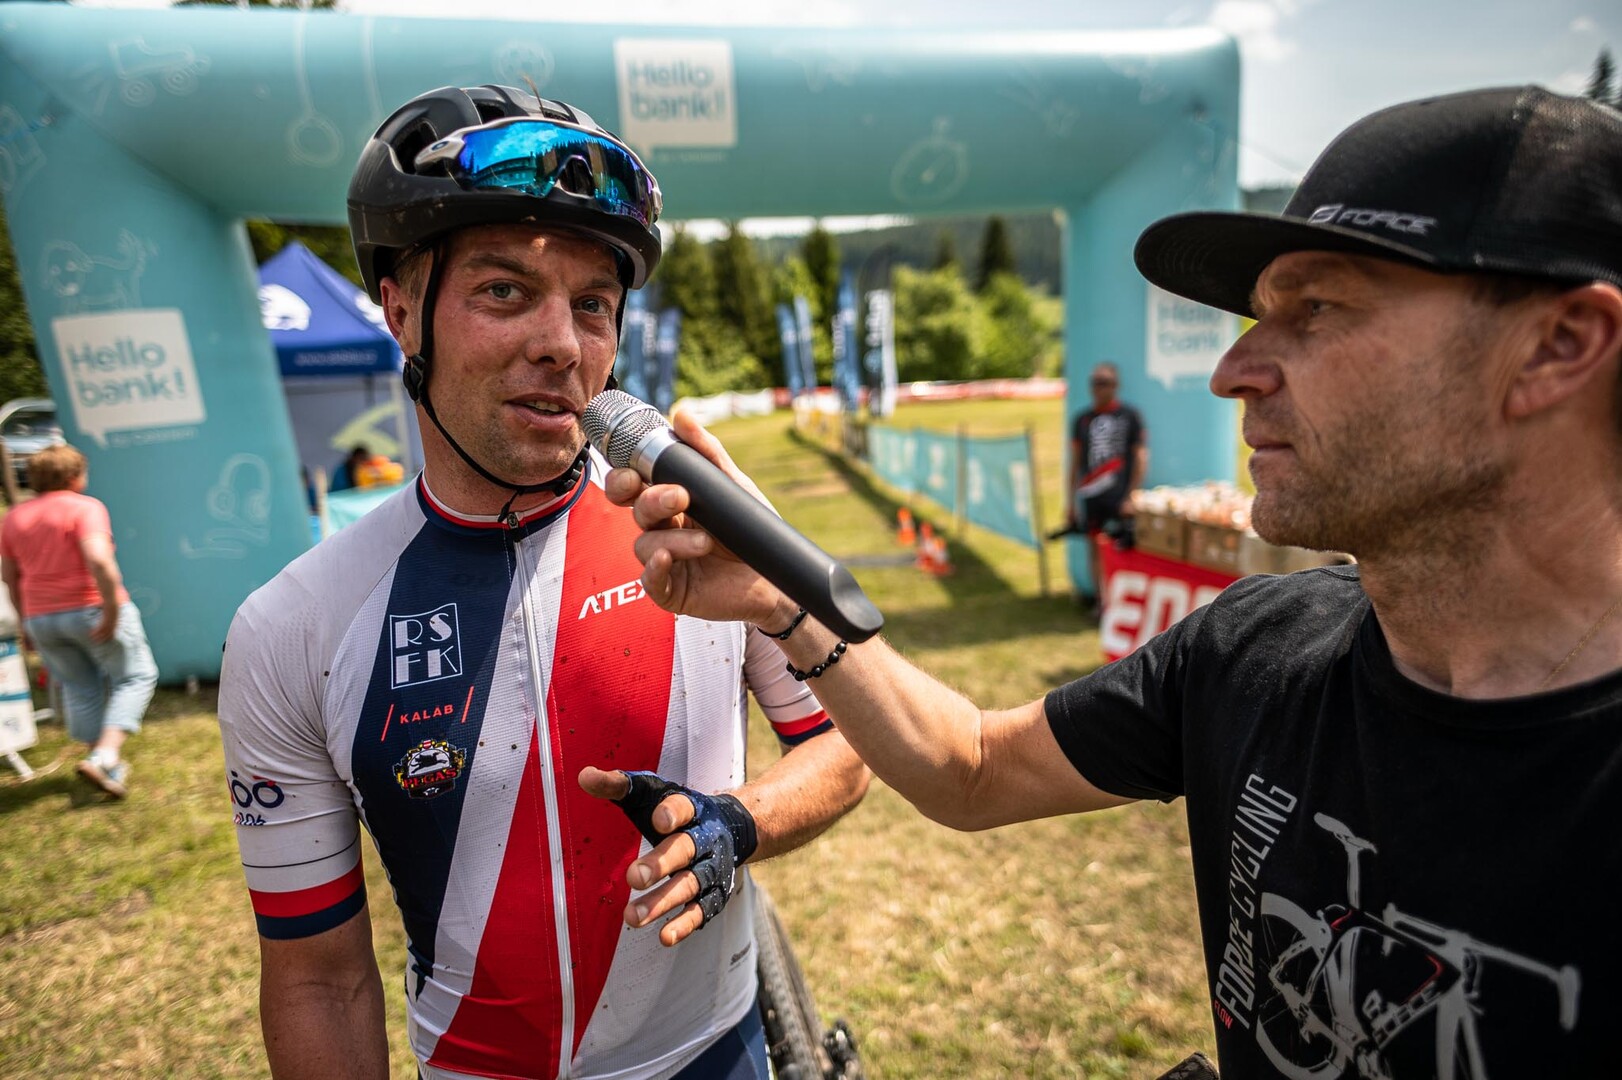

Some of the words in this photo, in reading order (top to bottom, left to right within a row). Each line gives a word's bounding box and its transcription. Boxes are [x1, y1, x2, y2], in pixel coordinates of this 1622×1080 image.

[627, 58, 714, 89] Hello
[630, 90, 725, 121] bank!
[1336, 208, 1437, 234] FORCE
[67, 337, 166, 372] Hello
[75, 368, 186, 408] bank!
[400, 704, 454, 725] KALAB
[402, 769, 458, 790] PEGAS
[1229, 773, 1298, 920] CYCLING
[1215, 904, 1256, 1030] FORCE
[1214, 1000, 1233, 1030] FLOW
